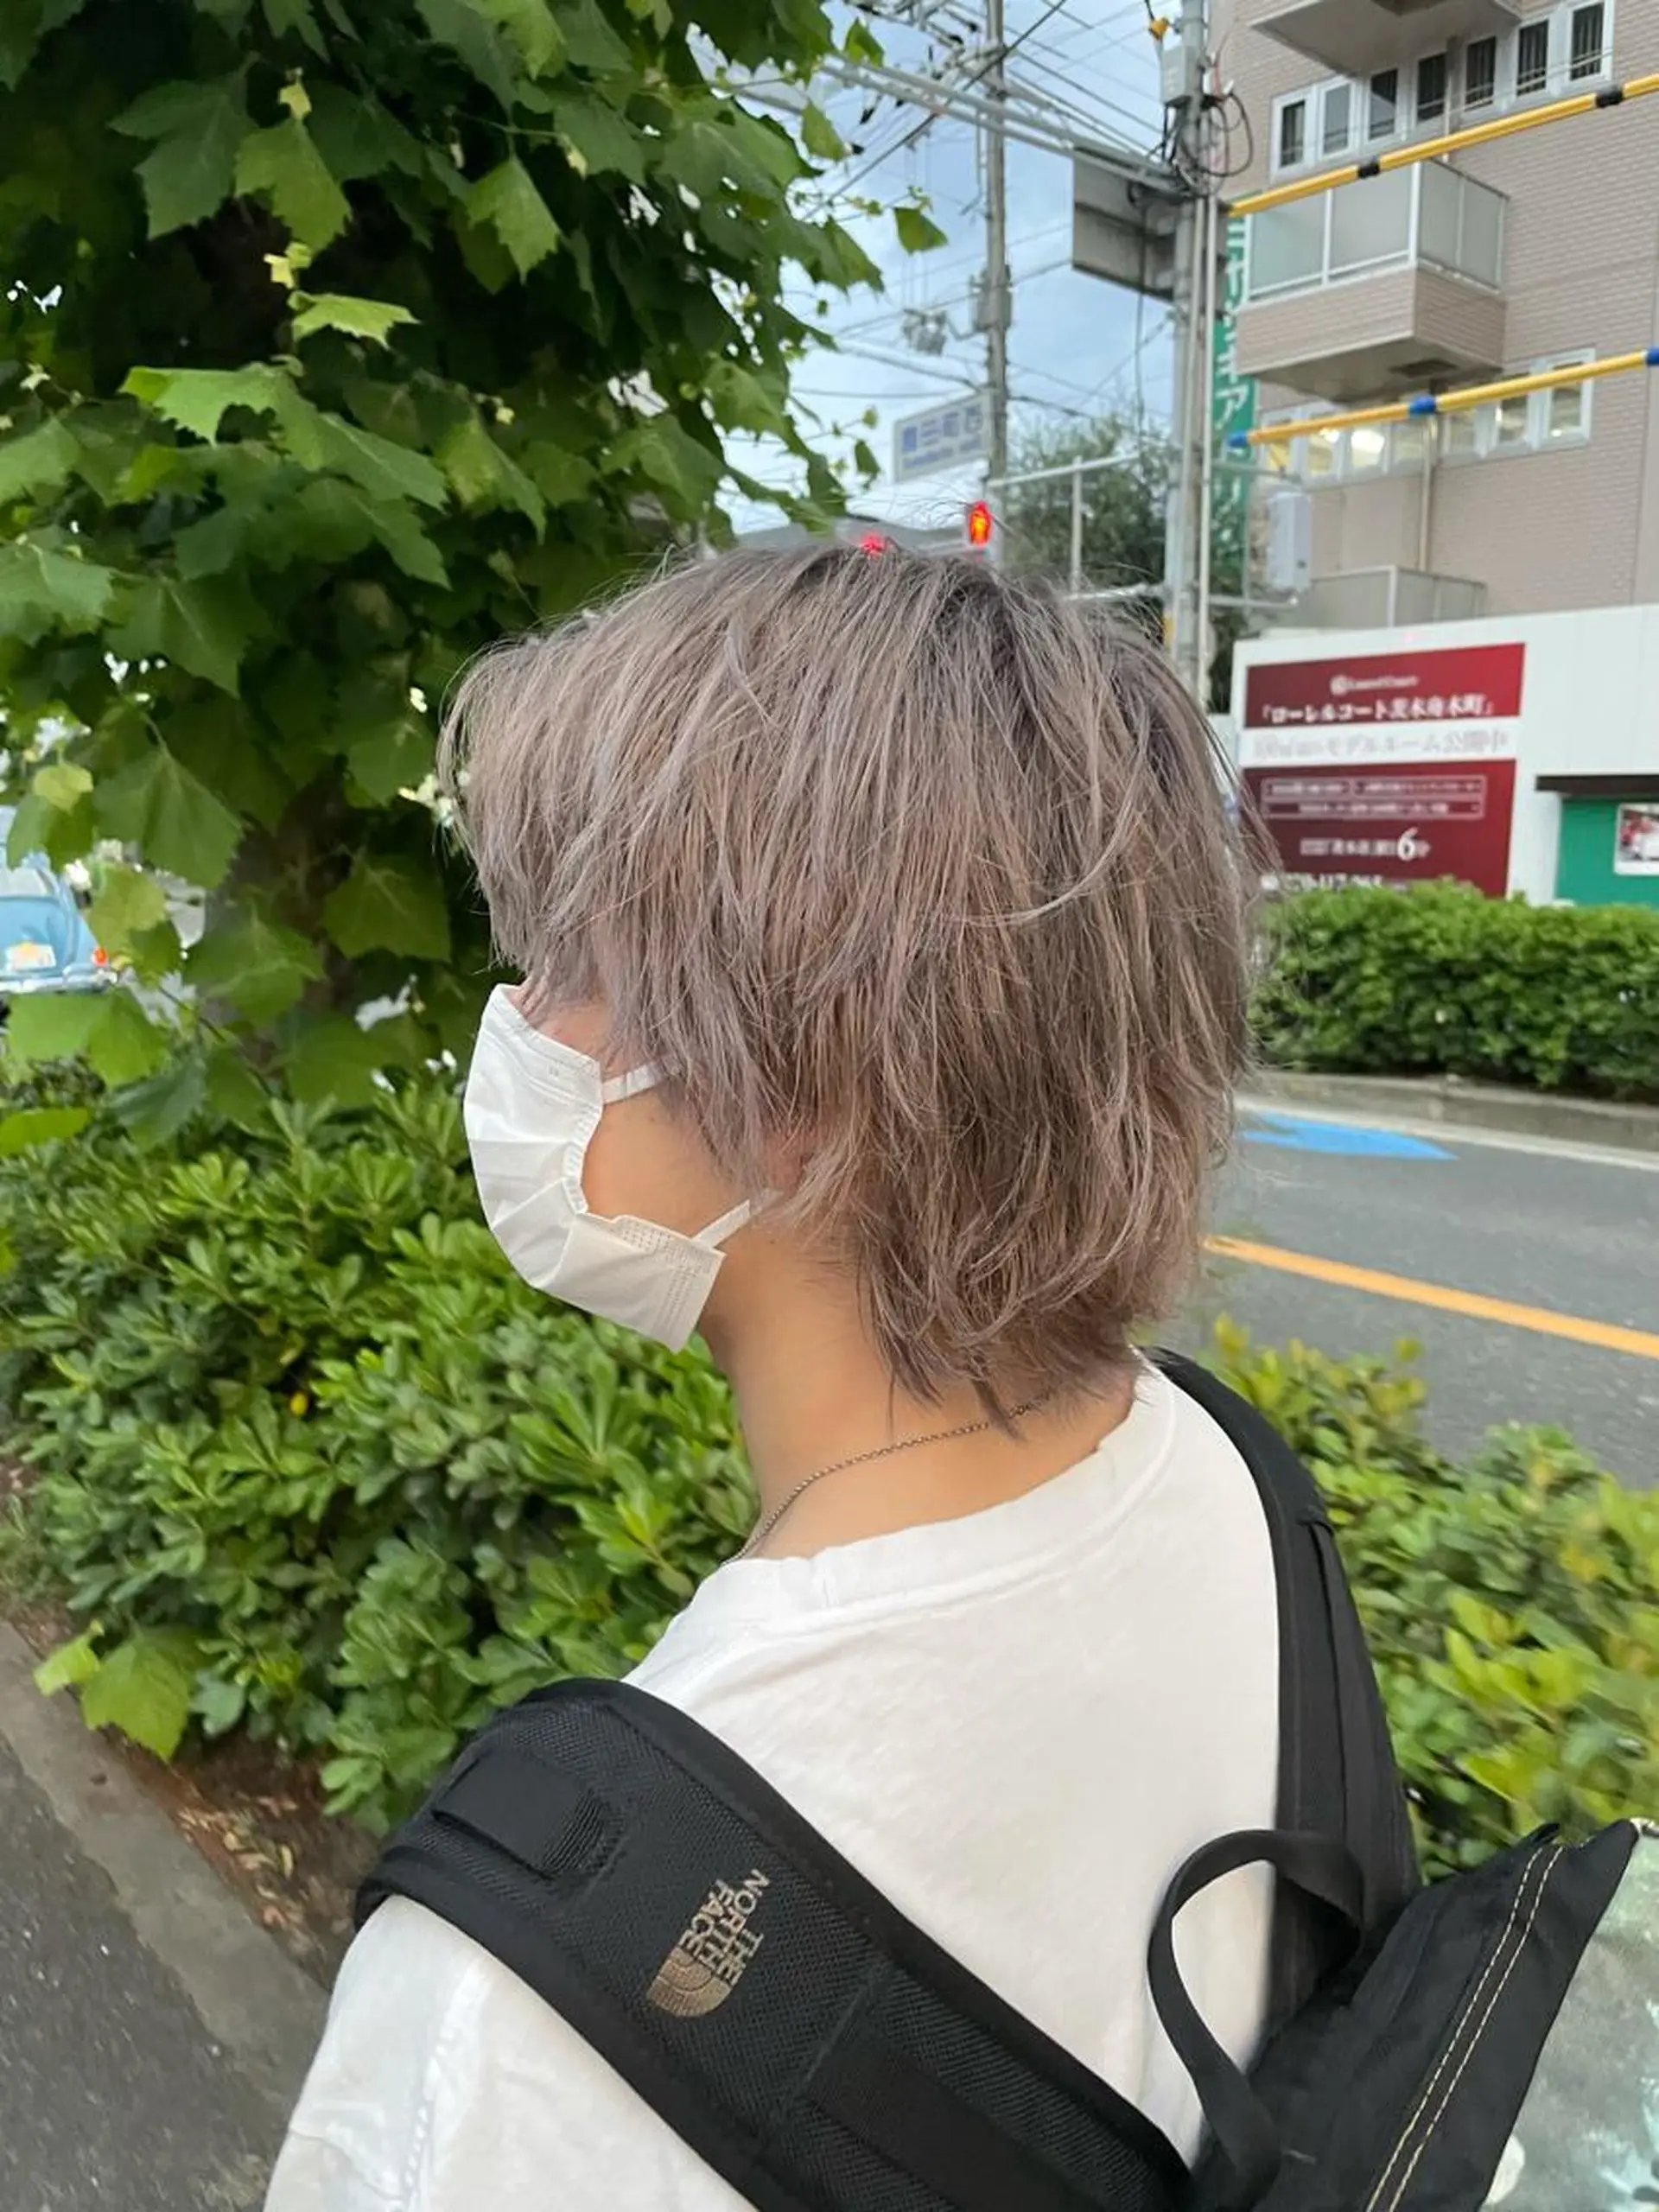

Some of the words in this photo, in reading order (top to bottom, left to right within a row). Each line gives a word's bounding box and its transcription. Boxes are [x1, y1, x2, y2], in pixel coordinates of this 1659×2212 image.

[678, 1878, 735, 1957] FACE
[698, 1868, 771, 1969] NORTH
[716, 1929, 764, 1986] THE
